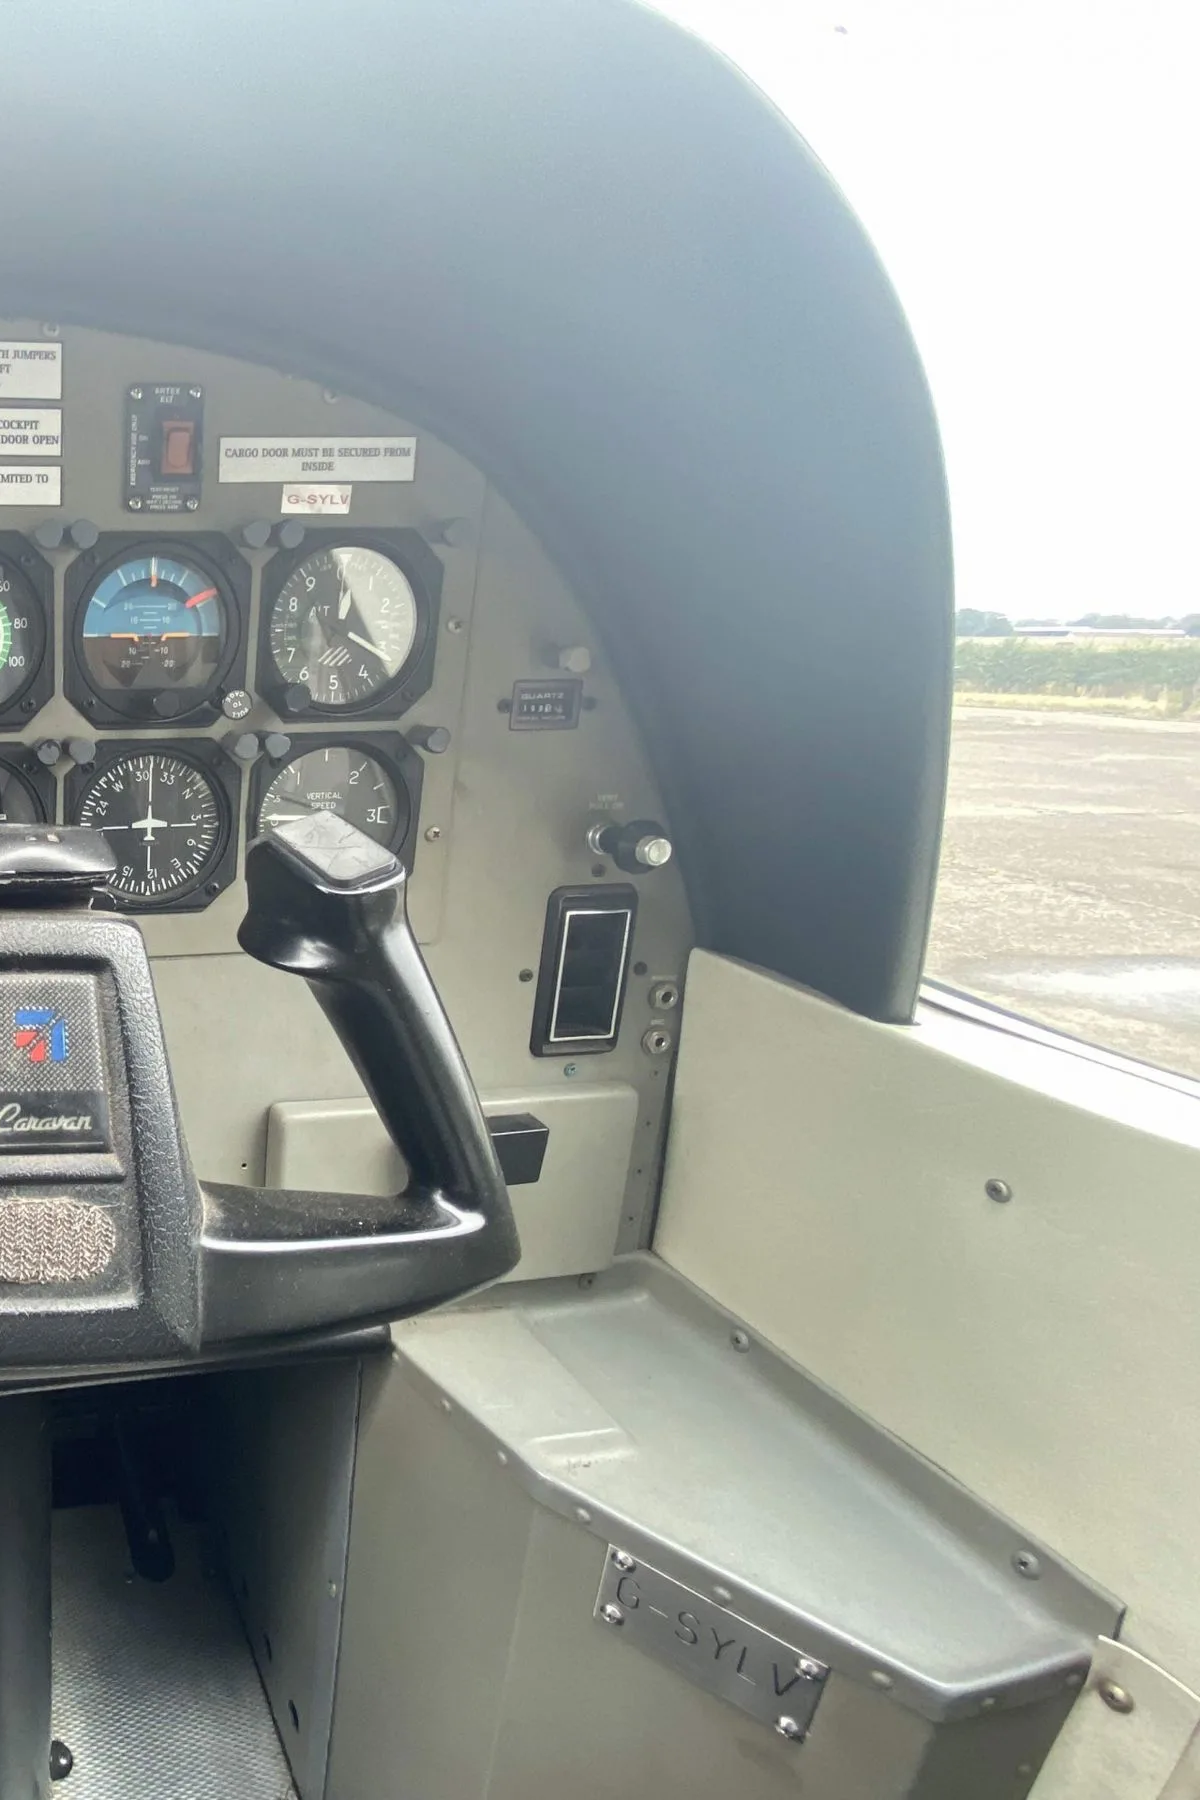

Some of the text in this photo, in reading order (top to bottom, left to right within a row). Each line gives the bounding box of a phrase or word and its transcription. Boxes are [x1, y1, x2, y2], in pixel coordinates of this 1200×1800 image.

[11, 350, 57, 361] JUMPERS
[0, 435, 29, 444] DOOR
[32, 435, 59, 445] OPEN
[225, 447, 411, 458] CARGO DOOR MUST BE SECURED FROM
[301, 462, 334, 471] INSIDE
[35, 474, 49, 484] TO
[287, 494, 349, 505] G-SYLV
[305, 577, 316, 592] 9
[288, 597, 298, 612] 8
[380, 598, 390, 613] 2
[13, 618, 28, 629] 80
[287, 648, 296, 663] 7
[8, 656, 25, 667] 100
[299, 667, 310, 681] 6
[358, 664, 369, 679] 4
[328, 675, 339, 690] 5
[521, 692, 564, 700] QUARTZ
[135, 771, 149, 782] 30
[160, 772, 176, 786] 33
[349, 771, 360, 785] 2
[306, 792, 342, 800] VERTICAL
[96, 800, 109, 816] 24
[311, 802, 336, 810] SPEED
[122, 865, 133, 877] 15
[147, 869, 158, 879] 12
[616, 1576, 801, 1697] G-SYLV
